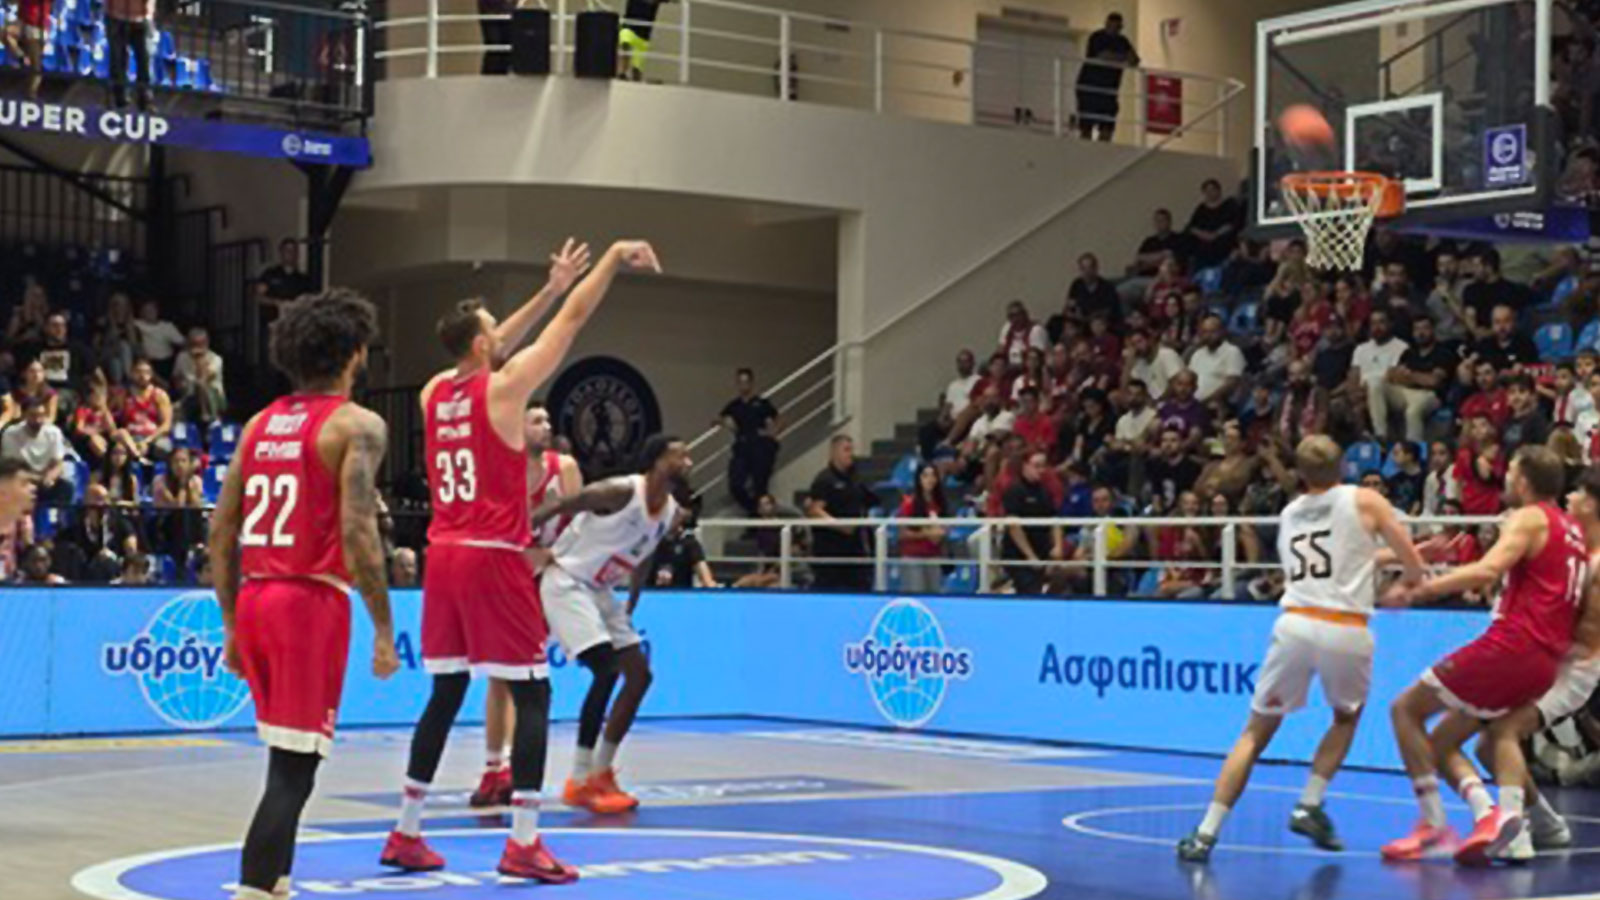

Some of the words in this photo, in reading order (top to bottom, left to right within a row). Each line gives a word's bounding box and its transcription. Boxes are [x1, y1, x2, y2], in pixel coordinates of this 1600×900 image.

[0, 101, 87, 135] UPER
[99, 111, 169, 141] CUP
[436, 448, 477, 503] 33
[239, 473, 298, 546] 22
[1290, 529, 1332, 582] 55
[106, 636, 223, 678] υδρόγ
[847, 639, 970, 680] υδρόγειος
[1038, 642, 1259, 698] Ασφαλιστικ
